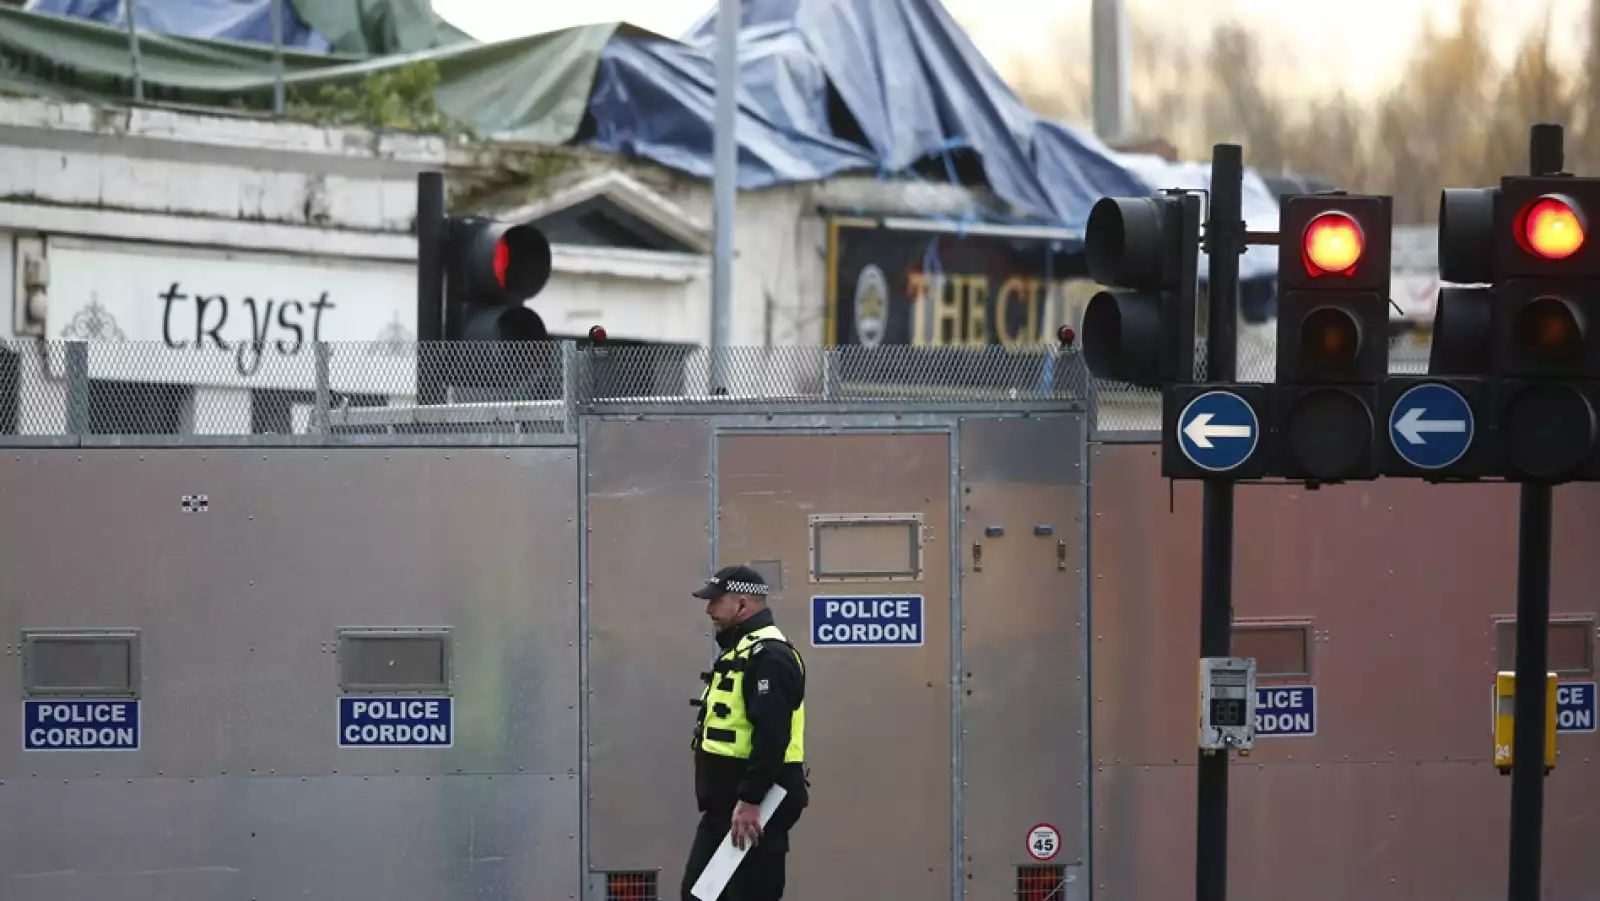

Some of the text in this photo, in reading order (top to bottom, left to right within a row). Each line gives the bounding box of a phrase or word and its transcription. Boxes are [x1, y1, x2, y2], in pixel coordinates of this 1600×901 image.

[908, 273, 988, 347] THE
[826, 600, 910, 618] POLICE
[818, 624, 917, 642] CORDON
[1255, 691, 1303, 708] LICE
[39, 705, 126, 722] POLICE
[353, 702, 439, 719] POLICE
[1254, 714, 1310, 731] RDON
[31, 729, 133, 746] CORDON
[345, 725, 446, 742] CORDON
[1033, 838, 1054, 851] 45
